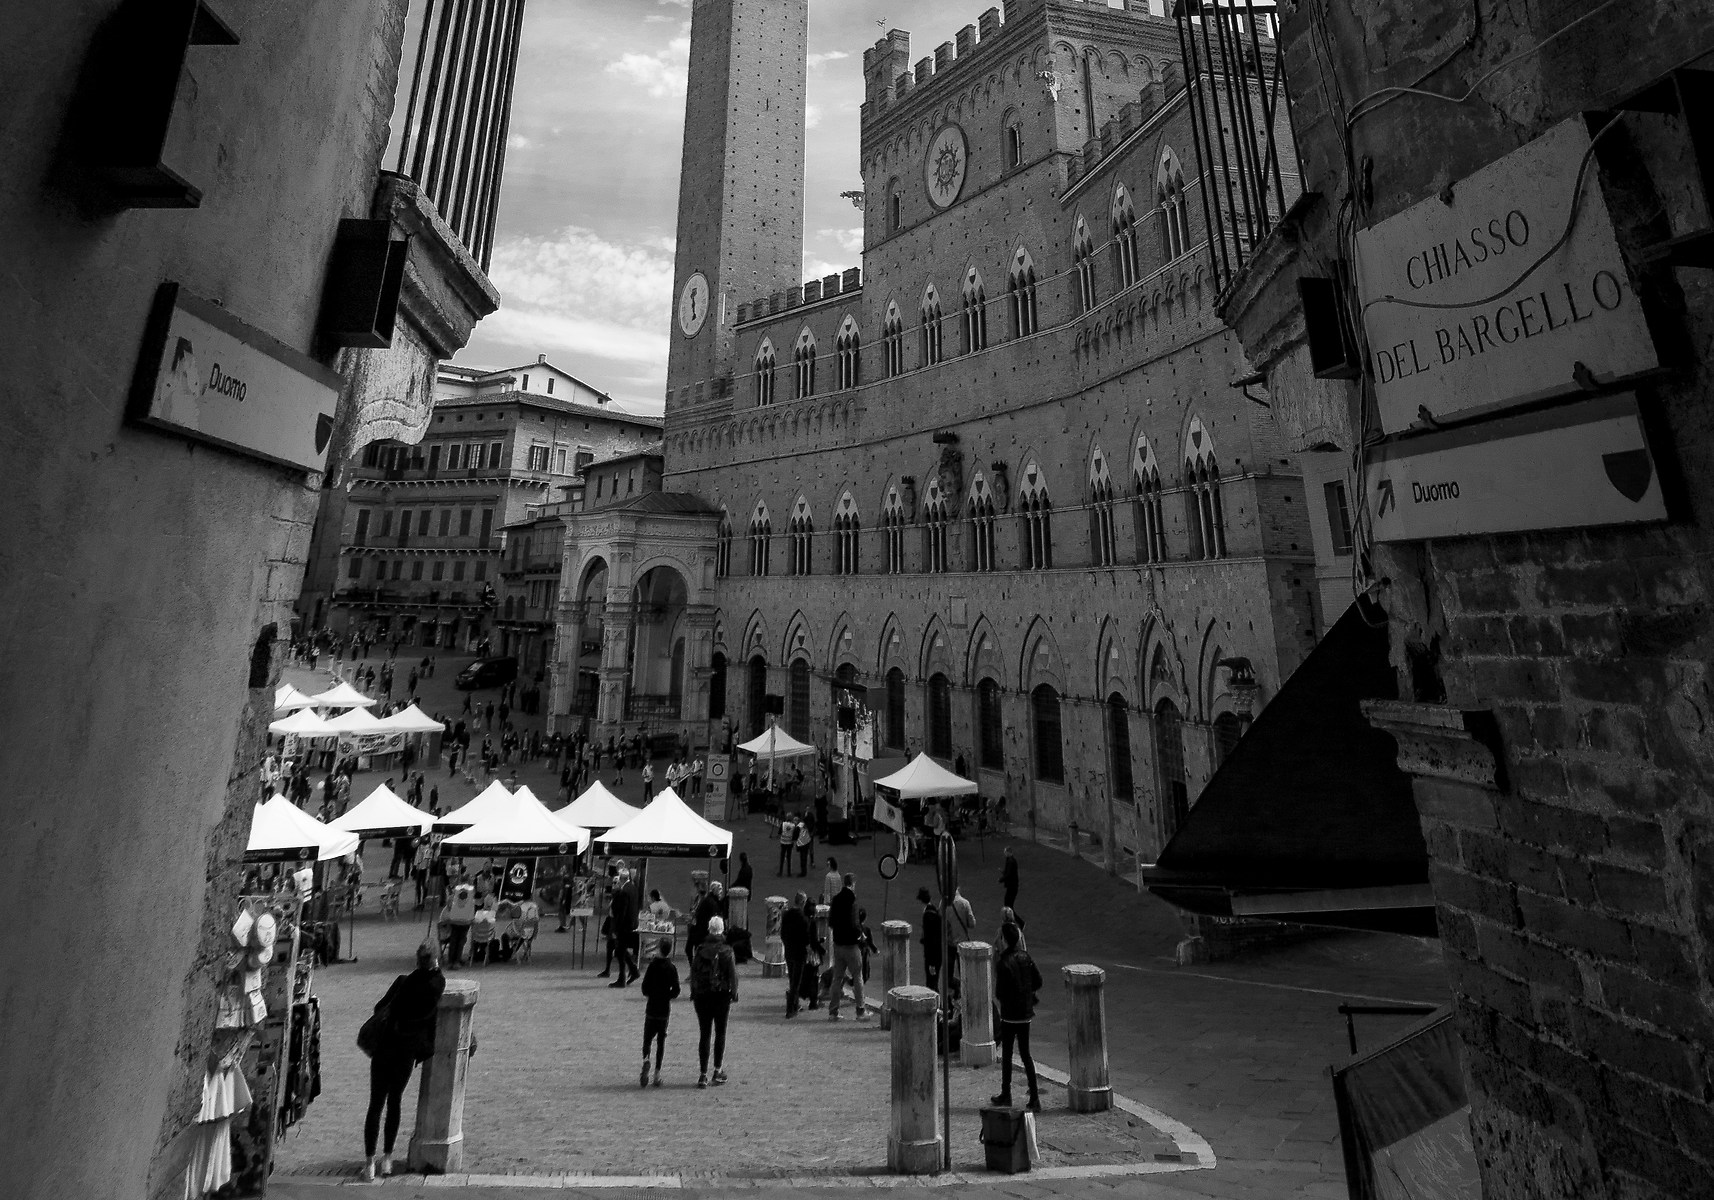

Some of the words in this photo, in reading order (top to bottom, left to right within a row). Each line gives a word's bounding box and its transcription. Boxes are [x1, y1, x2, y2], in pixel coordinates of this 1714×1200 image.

[1407, 210, 1529, 289] CHIASSO
[1377, 340, 1430, 384] DEL
[1435, 270, 1621, 364] BARGELLO
[209, 363, 247, 402] Duomo
[1412, 481, 1460, 503] Duomo
